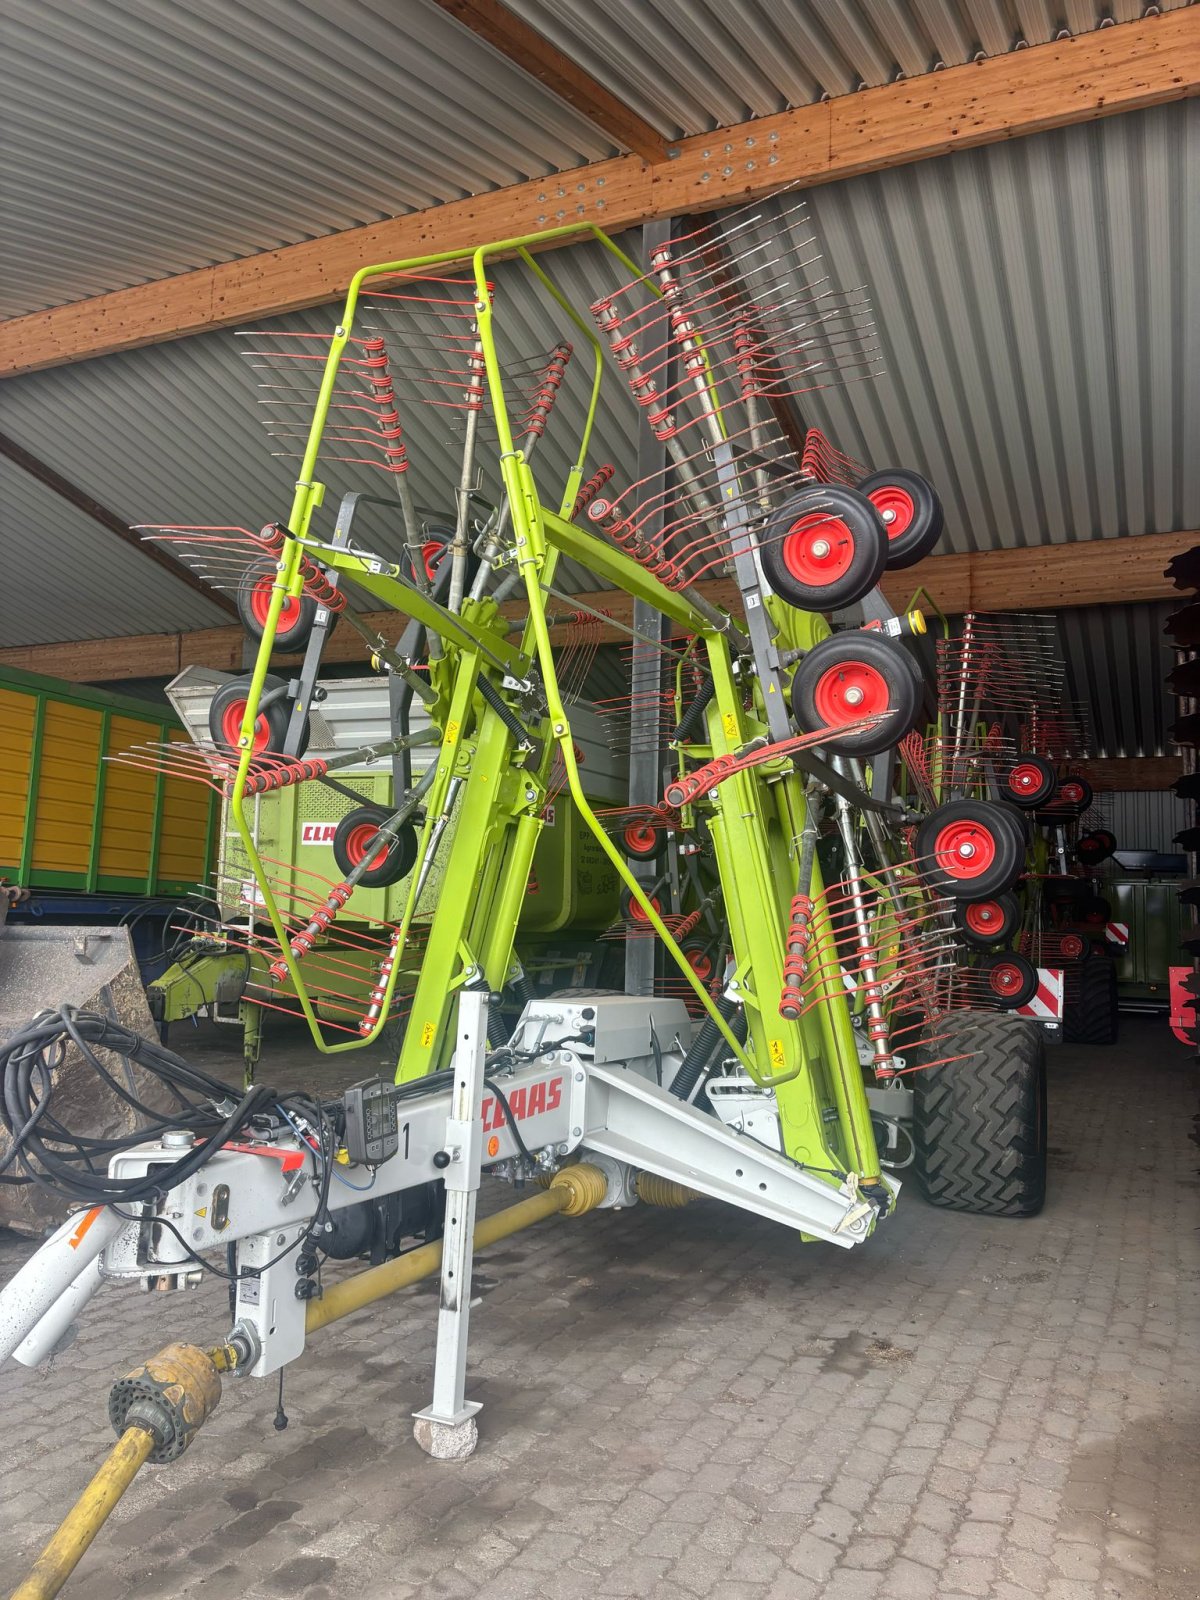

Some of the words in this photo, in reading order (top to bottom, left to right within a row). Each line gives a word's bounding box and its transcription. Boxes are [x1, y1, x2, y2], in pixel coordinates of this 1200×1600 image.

[303, 826, 337, 841] CLA
[481, 1076, 563, 1133] CLAAS
[402, 1121, 410, 1160] 1
